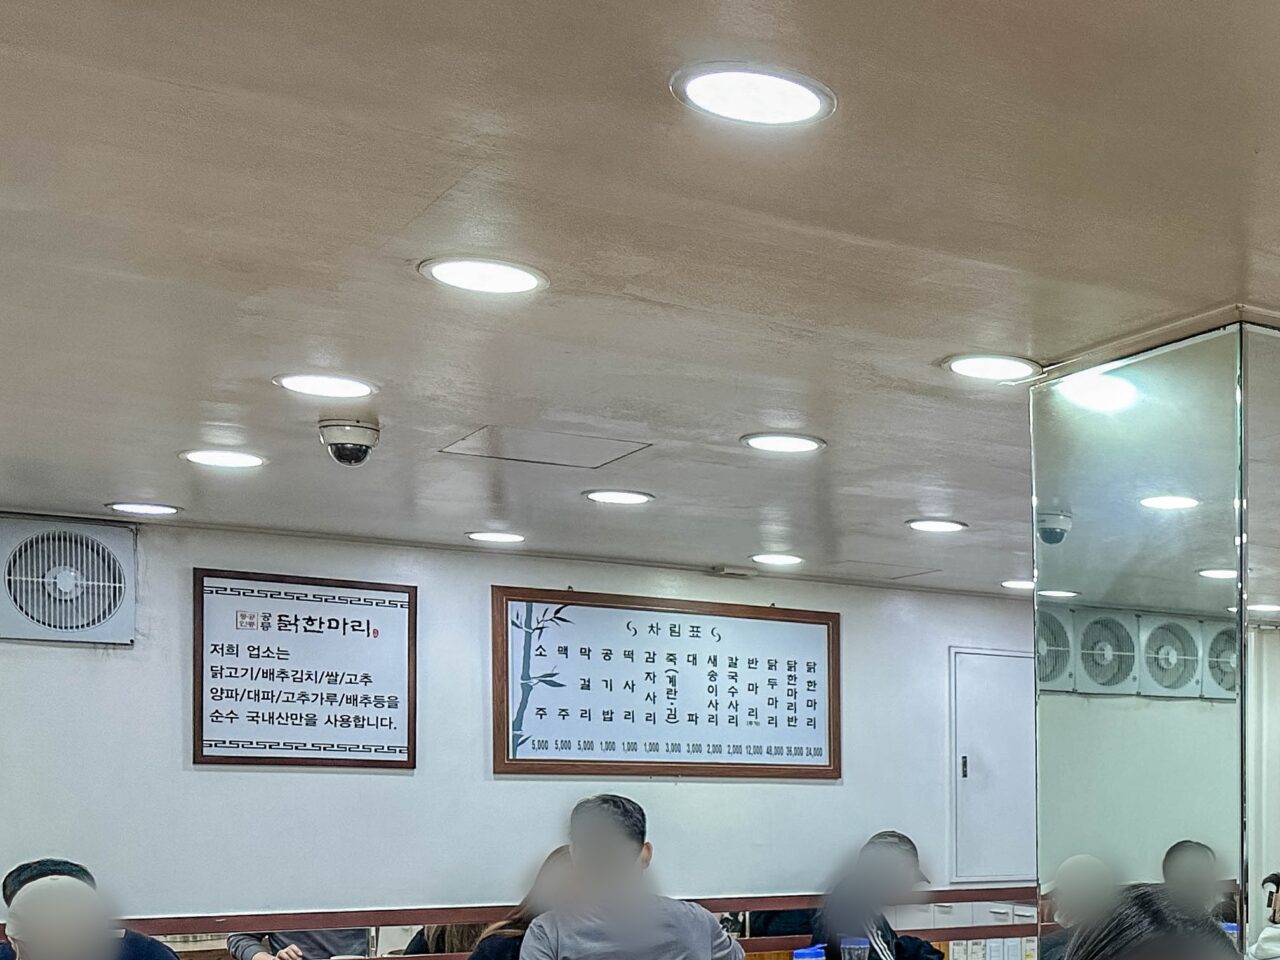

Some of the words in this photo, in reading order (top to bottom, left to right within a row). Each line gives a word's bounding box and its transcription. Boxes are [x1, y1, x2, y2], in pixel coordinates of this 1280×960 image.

[277, 614, 370, 637] 닭한마리
[648, 622, 702, 639] 차림표
[209, 643, 239, 658] 저희
[247, 645, 291, 661] 업소는
[209, 665, 373, 687] 닭고기/배추김치/쌀/고추
[209, 687, 400, 709] 양파/대파/고추가루/배추등을
[209, 709, 239, 724] 순수
[246, 710, 318, 727] 국내산만을
[324, 714, 398, 730] 사용합니다.
[532, 739, 549, 751] 5,000
[555, 740, 571, 751] 5,000
[578, 740, 594, 752] 5,000
[600, 740, 616, 752] 1,000
[622, 741, 637, 752] 1,000
[644, 741, 659, 753] 1,000
